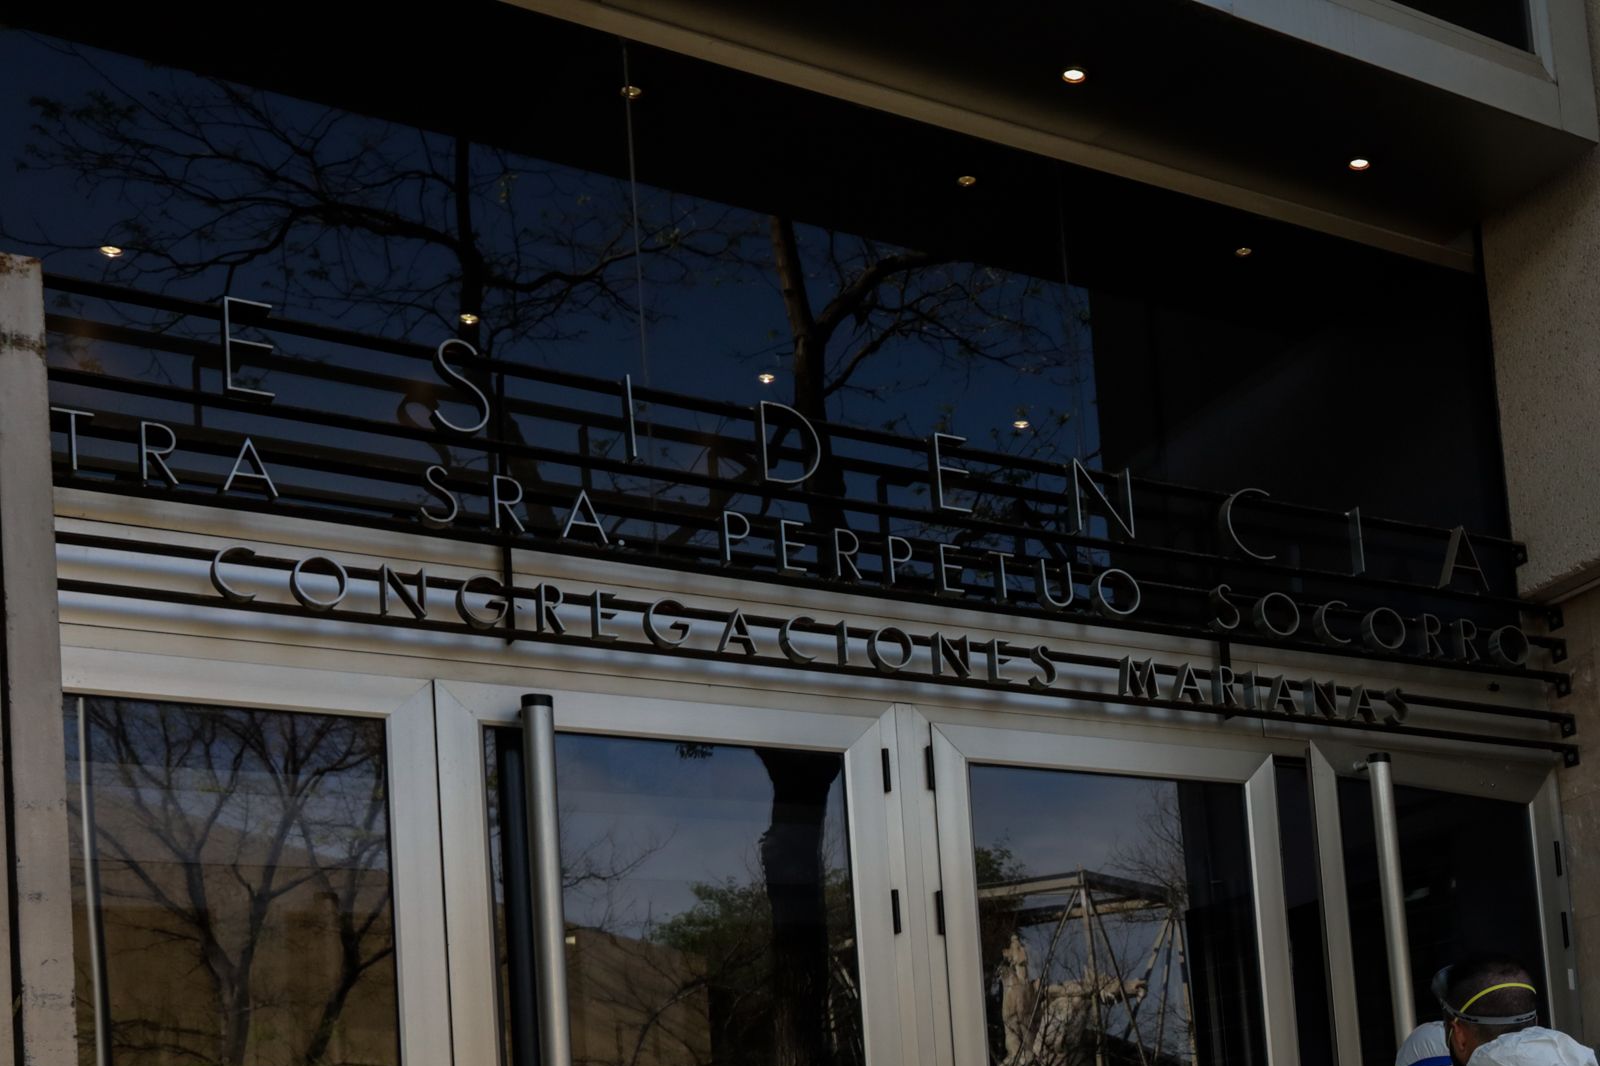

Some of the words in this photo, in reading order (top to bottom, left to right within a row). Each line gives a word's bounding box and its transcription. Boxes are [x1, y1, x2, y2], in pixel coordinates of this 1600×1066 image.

[50, 406, 279, 499] TRA
[718, 509, 1142, 617] PERPETUO
[1208, 584, 1530, 666] SOCORRO
[209, 546, 1059, 690] CONGREGACIONES
[1116, 653, 1409, 725] MARIANAS
